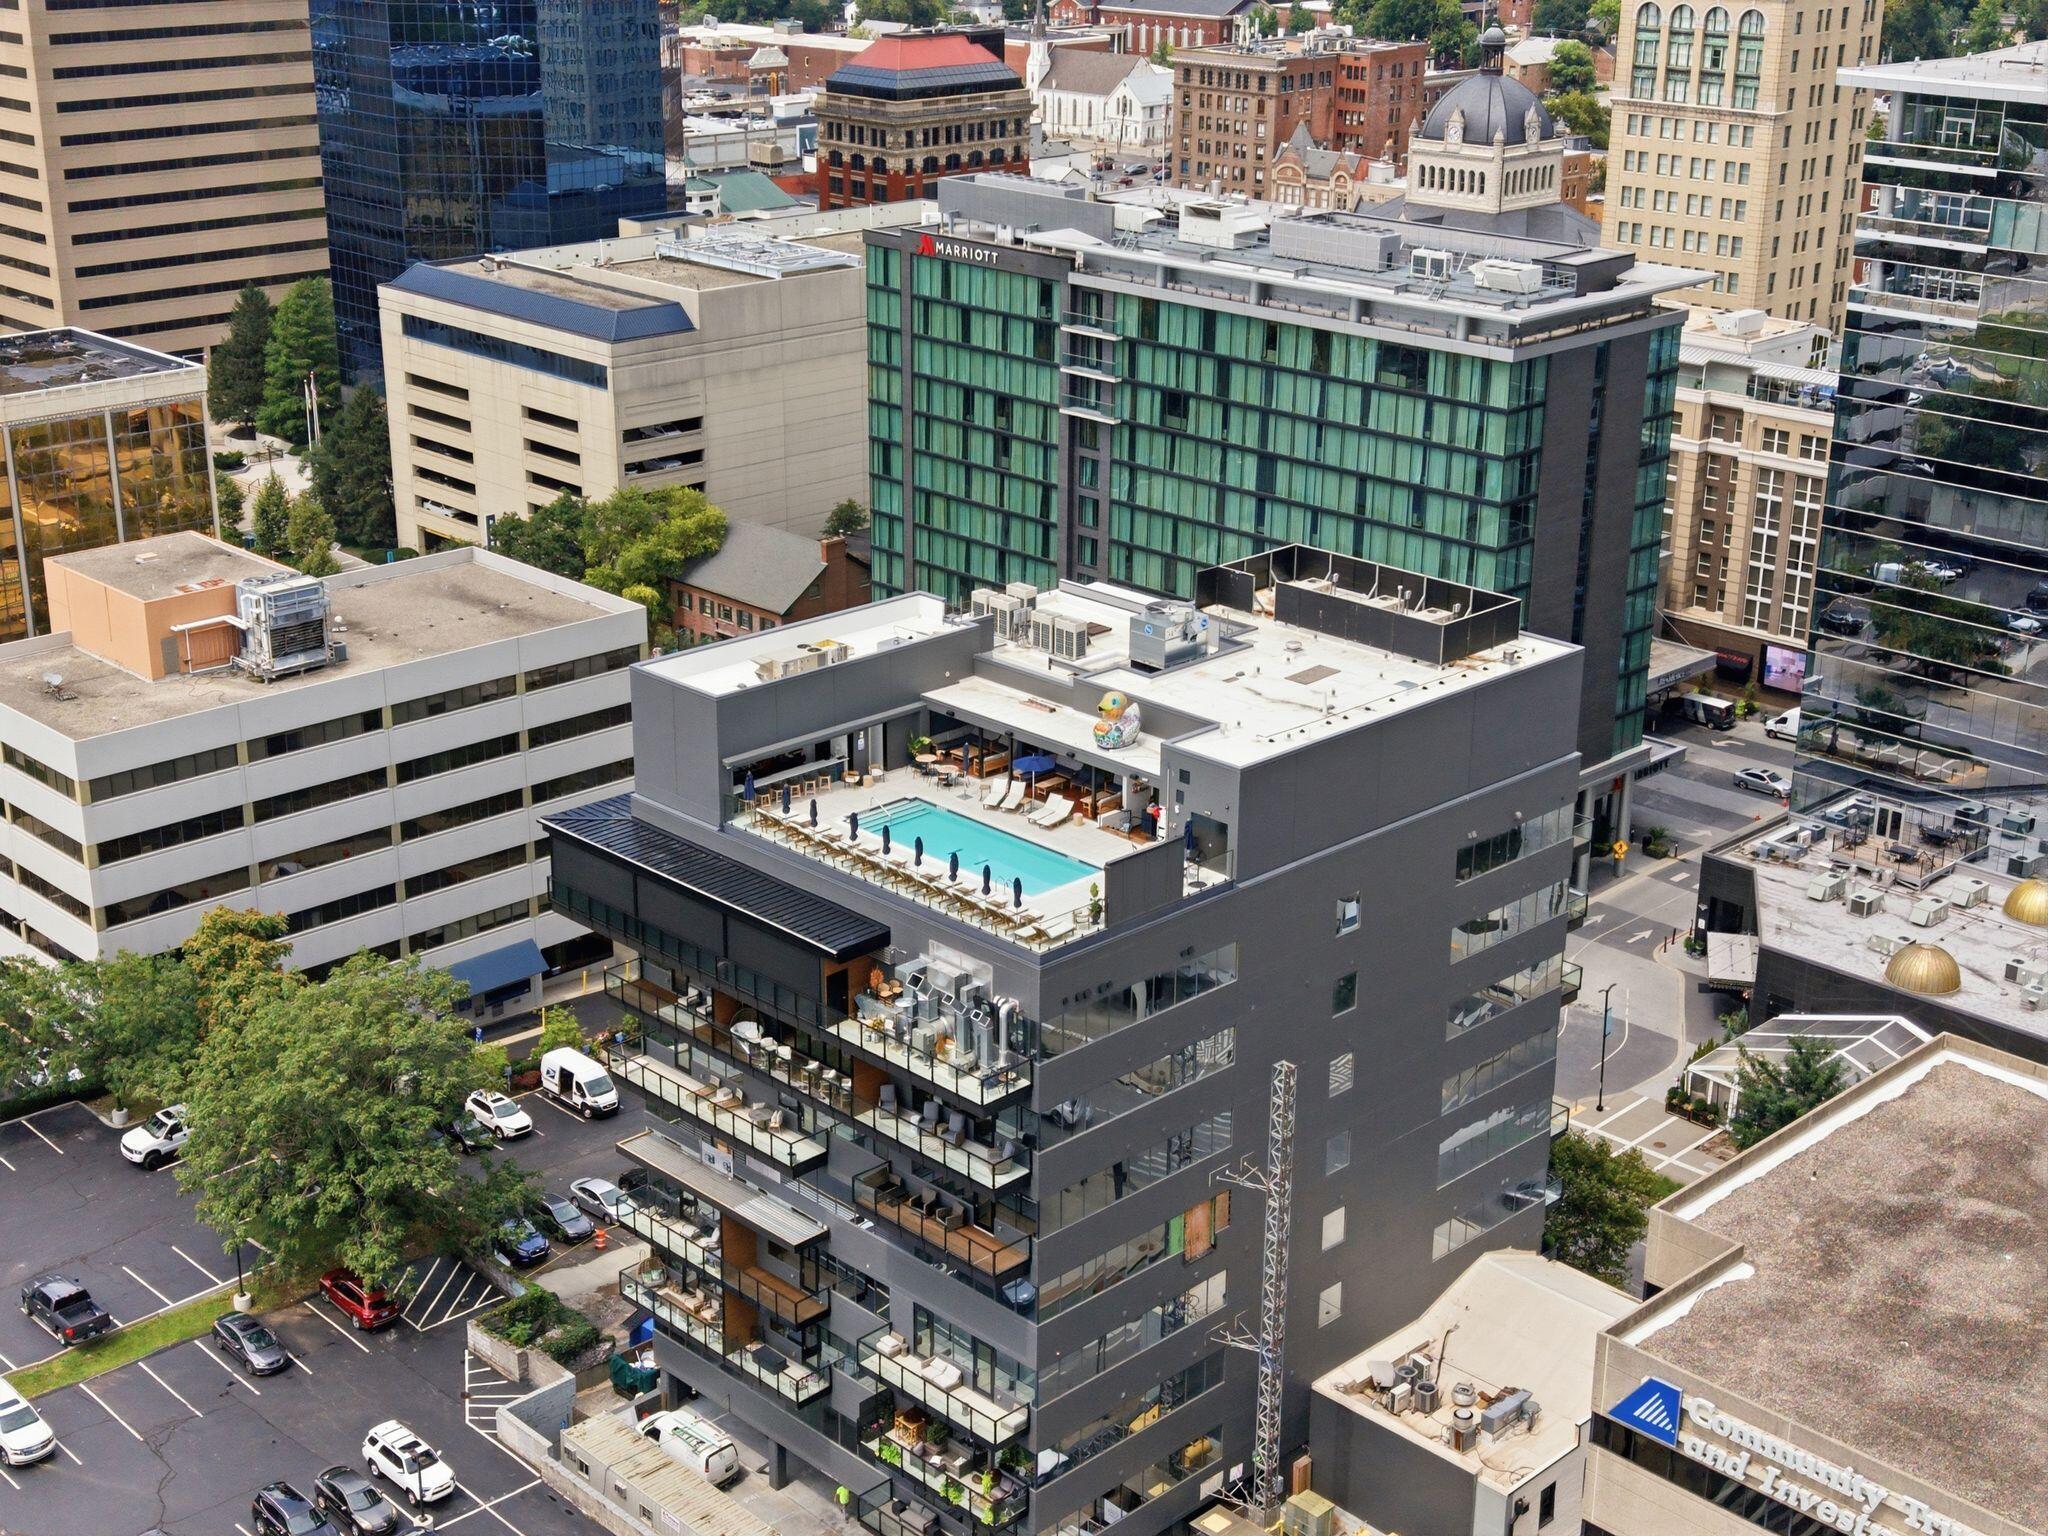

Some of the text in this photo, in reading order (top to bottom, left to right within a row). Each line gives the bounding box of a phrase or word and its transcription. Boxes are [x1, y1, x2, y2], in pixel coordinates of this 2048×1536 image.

[935, 241, 999, 264] MARRIOTT
[1683, 1435, 1751, 1481] and
[1688, 1397, 1889, 1515] Community
